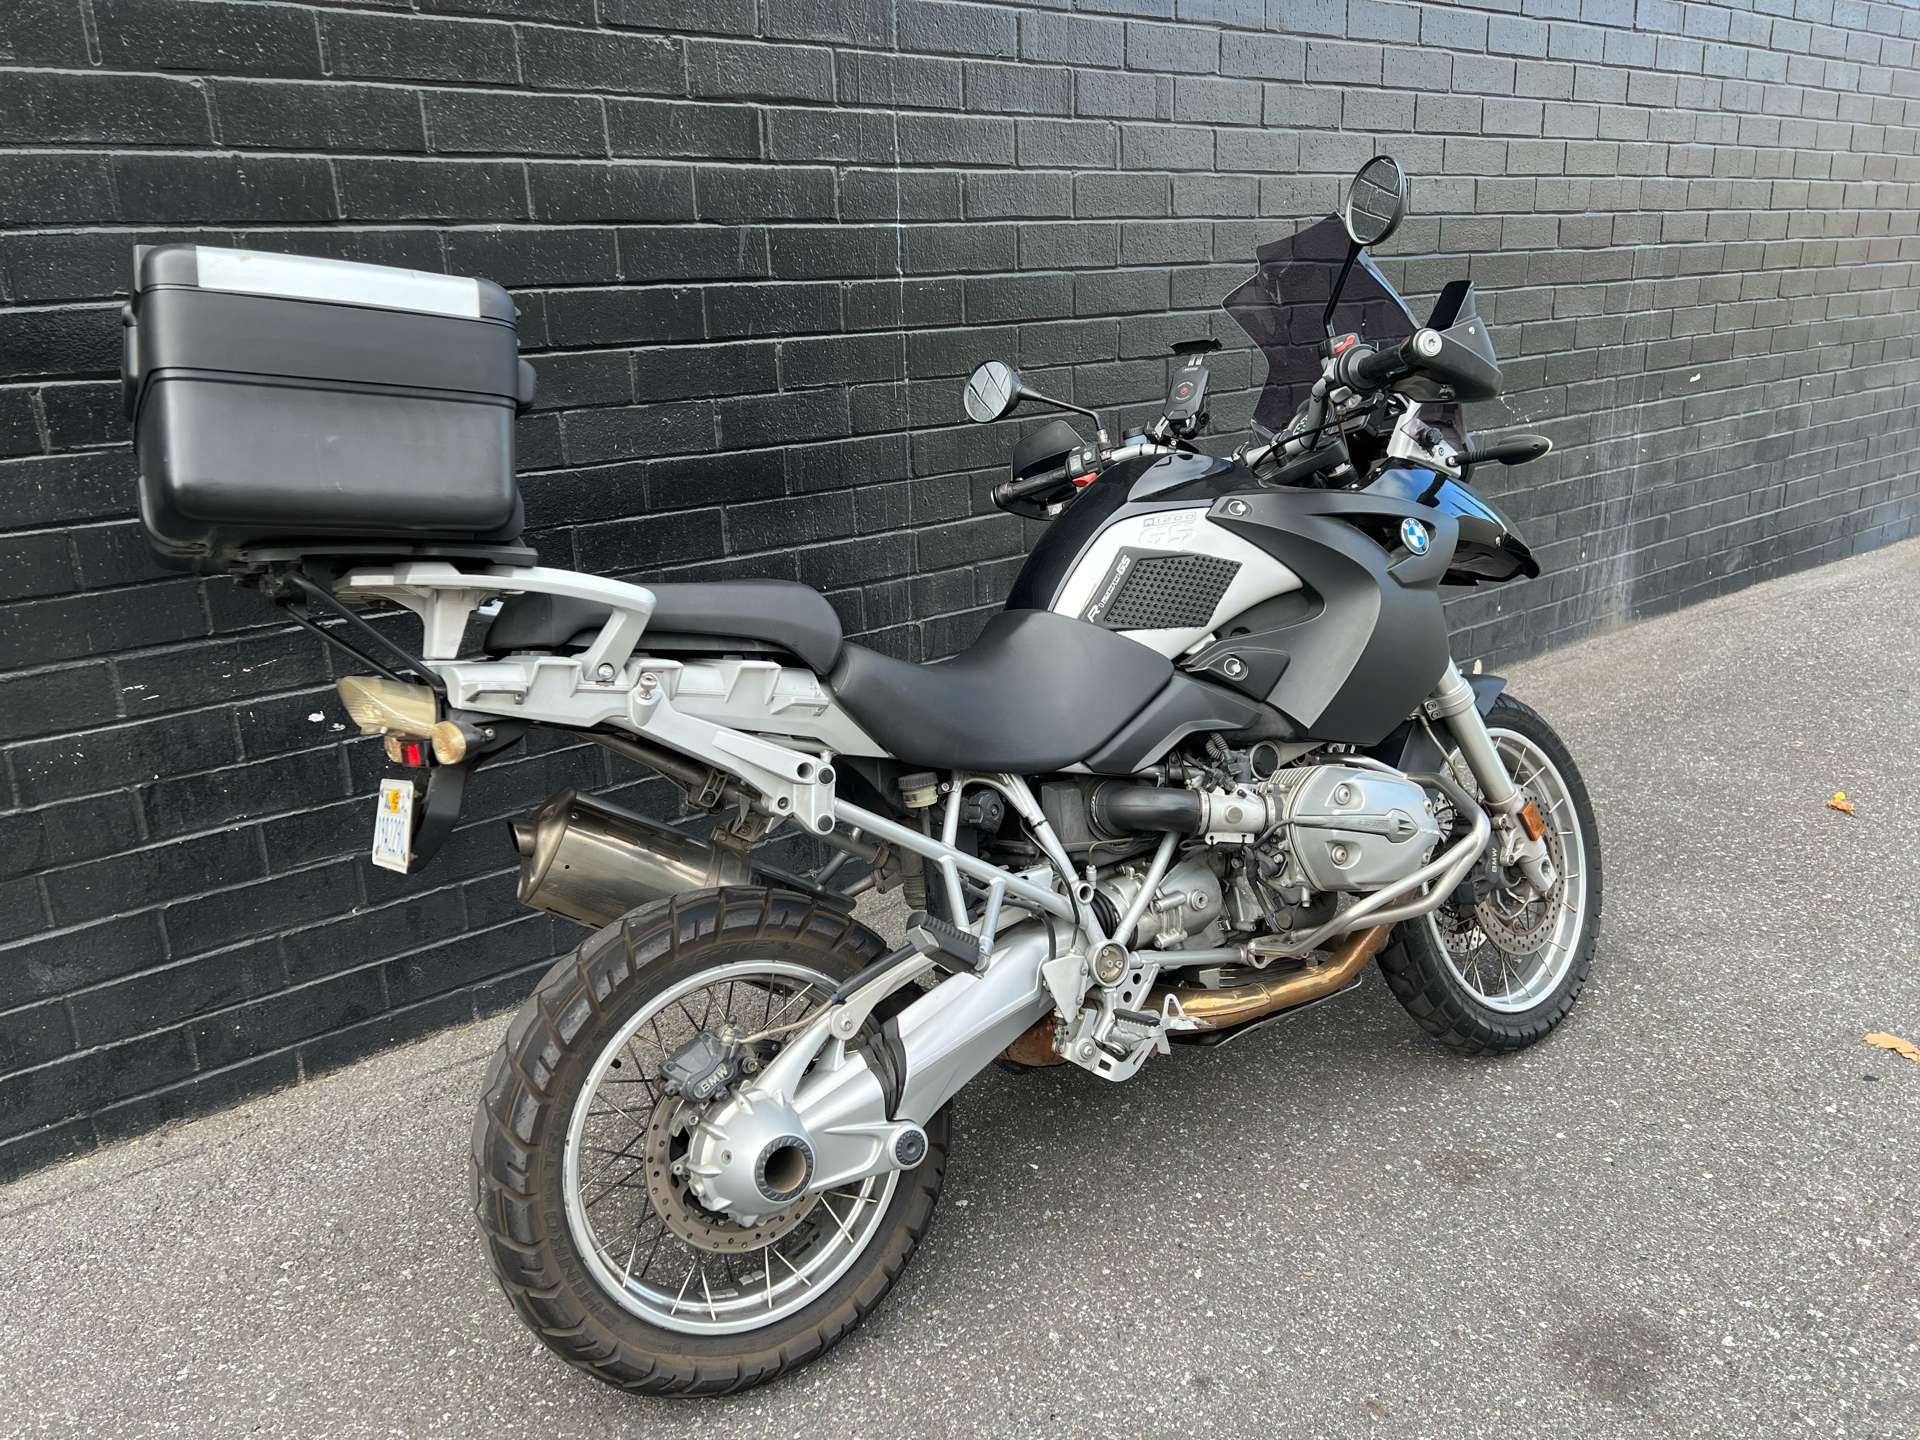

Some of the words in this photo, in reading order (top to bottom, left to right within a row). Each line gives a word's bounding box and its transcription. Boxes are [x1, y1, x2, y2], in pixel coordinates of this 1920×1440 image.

[1491, 847, 1499, 873] BMW
[700, 1063, 728, 1093] BMW
[544, 1210, 621, 1329] SHINKO
